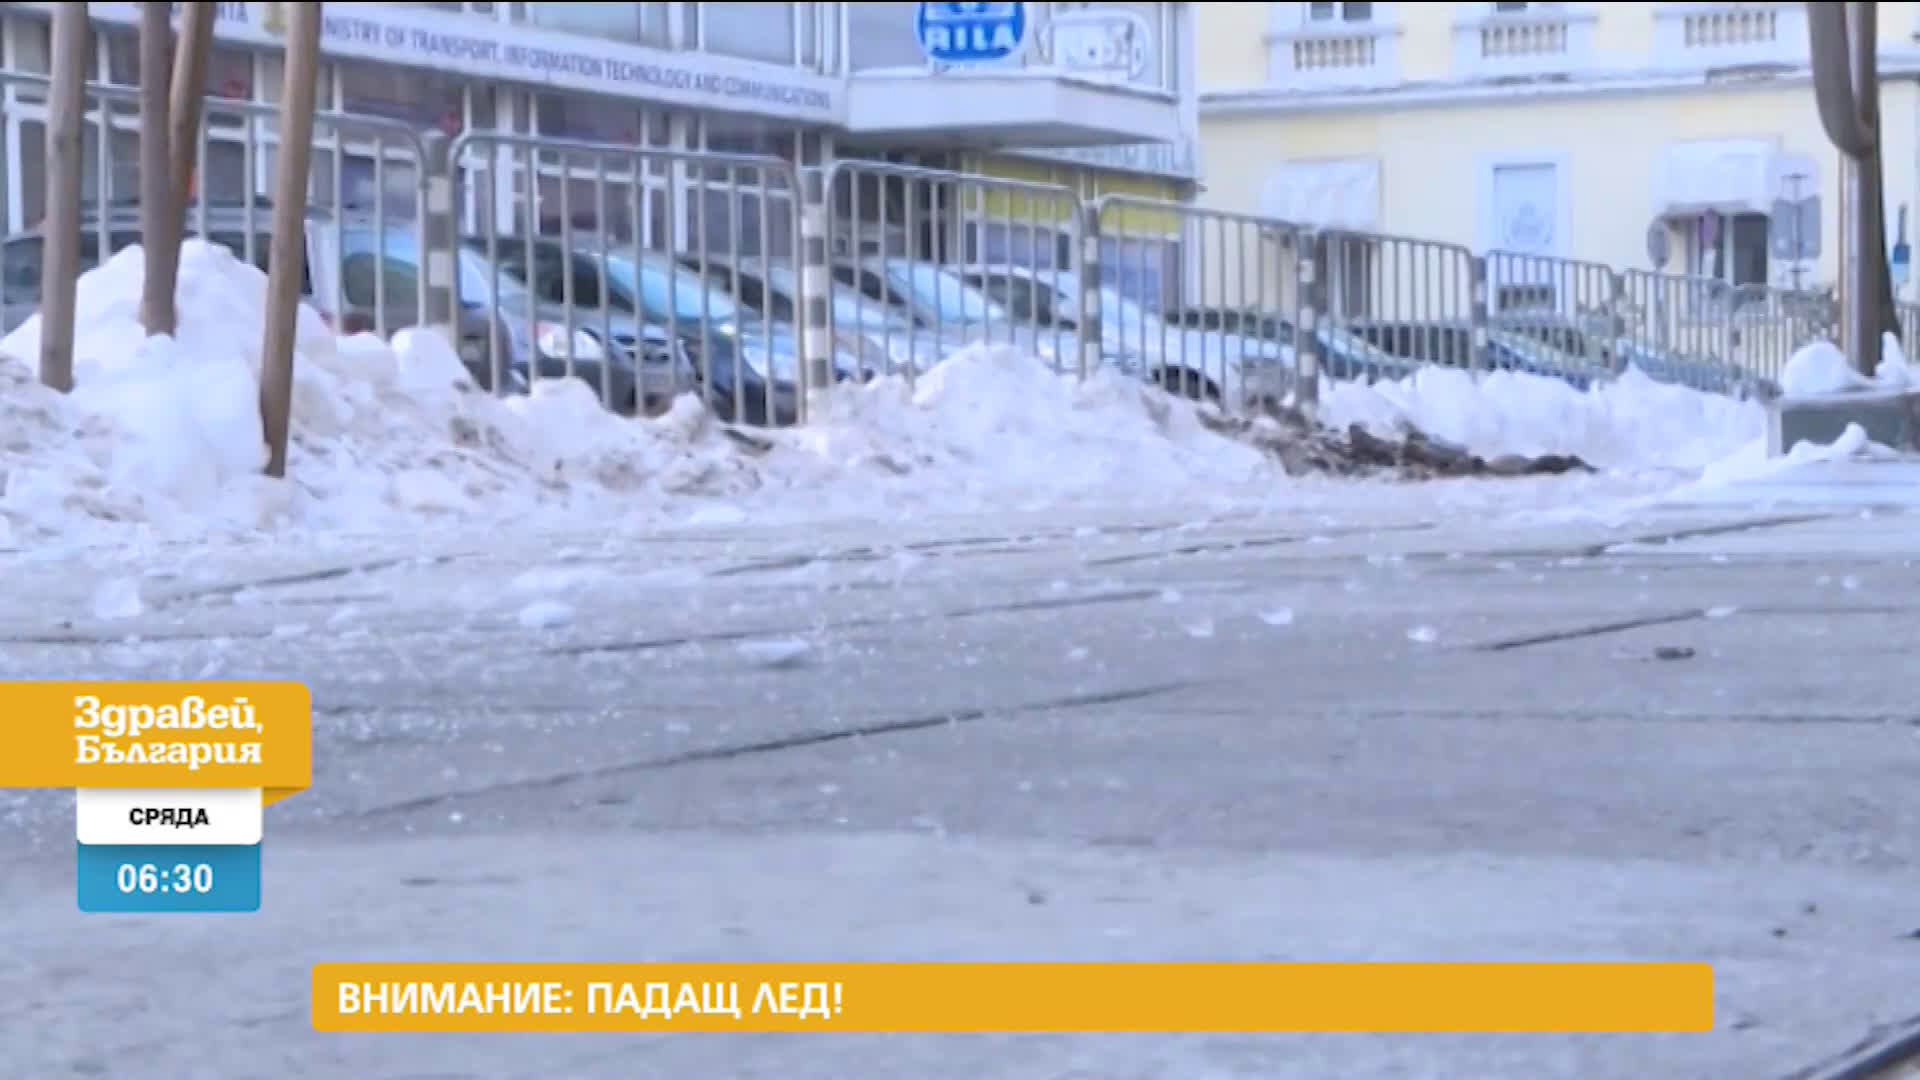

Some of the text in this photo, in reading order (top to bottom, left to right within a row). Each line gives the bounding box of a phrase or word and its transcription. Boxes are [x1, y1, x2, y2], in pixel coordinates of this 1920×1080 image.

[325, 16, 383, 46] NISTRY
[385, 24, 407, 47] OF
[504, 44, 603, 77] INFORMATION
[605, 59, 692, 90] TECHNOLOGY
[694, 75, 721, 95] AND
[722, 77, 831, 109] COMMUNICATIONS
[926, 24, 1014, 51] RILA
